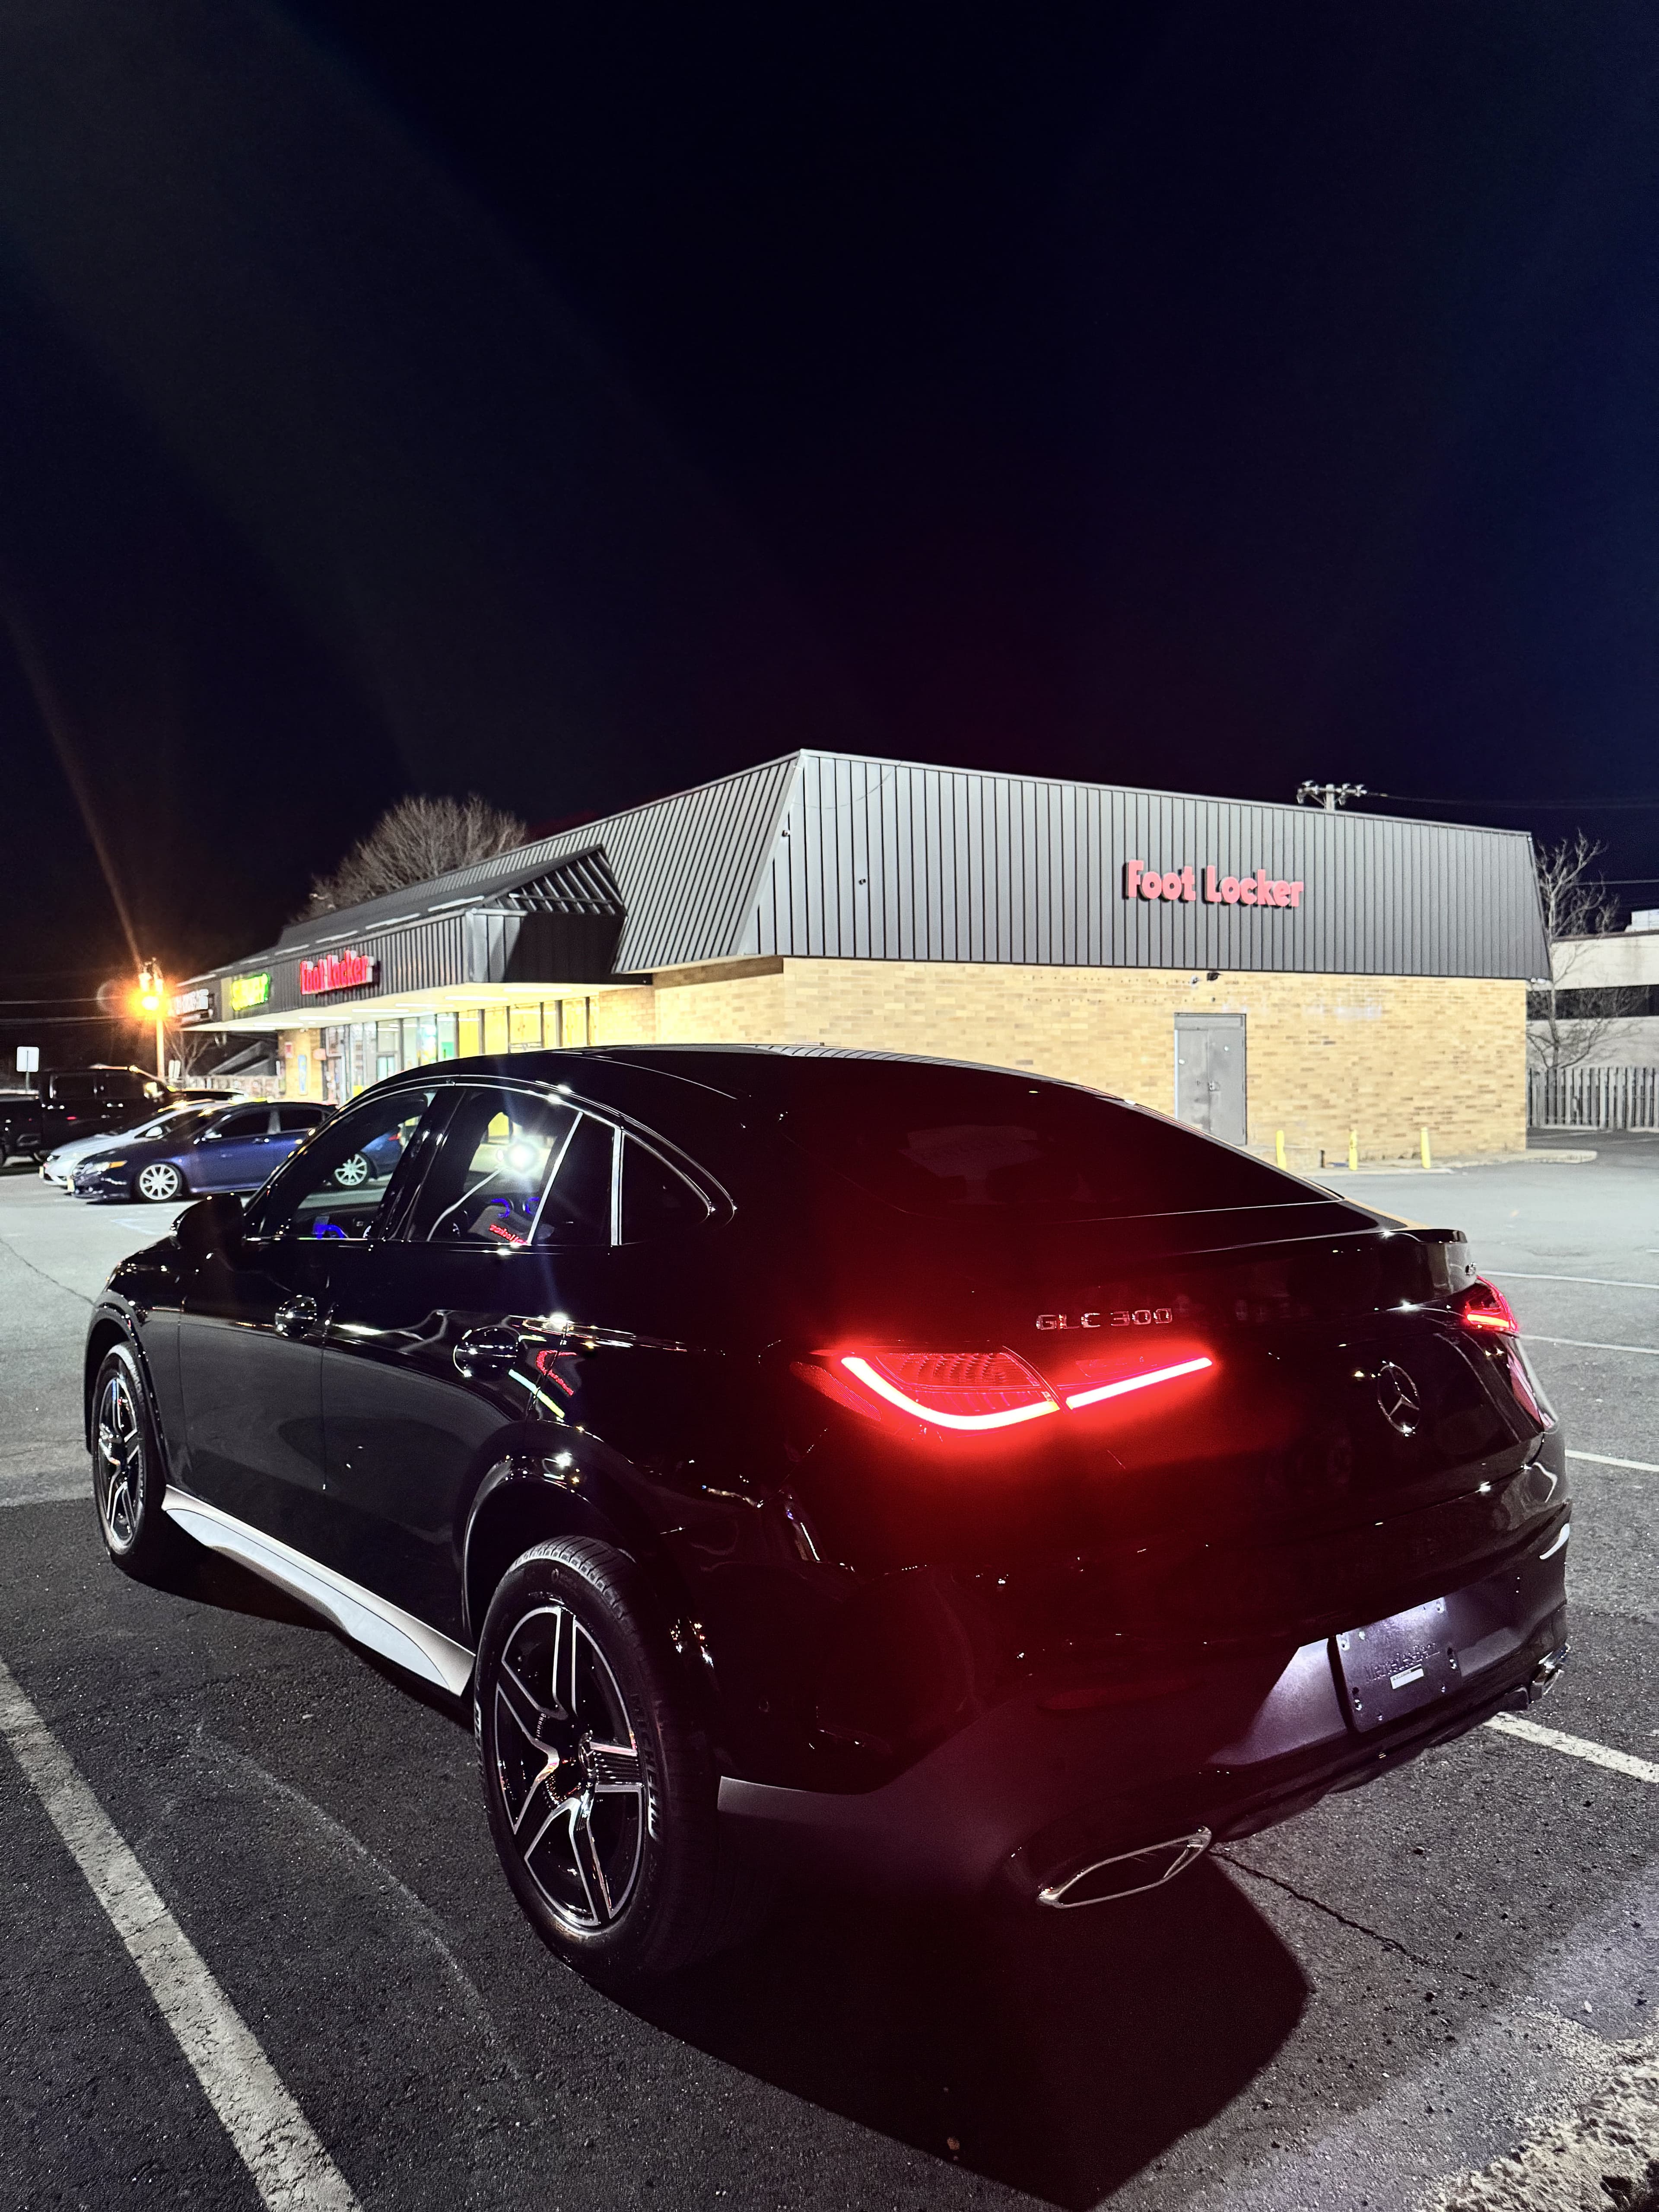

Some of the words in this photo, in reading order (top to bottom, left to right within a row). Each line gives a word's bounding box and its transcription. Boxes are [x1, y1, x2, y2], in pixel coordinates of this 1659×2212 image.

[1128, 860, 1196, 901] Foot
[1207, 865, 1304, 907] Locker
[327, 950, 372, 989] Locker
[1036, 1313, 1100, 1330] GLC
[1110, 1308, 1173, 1326] 300
